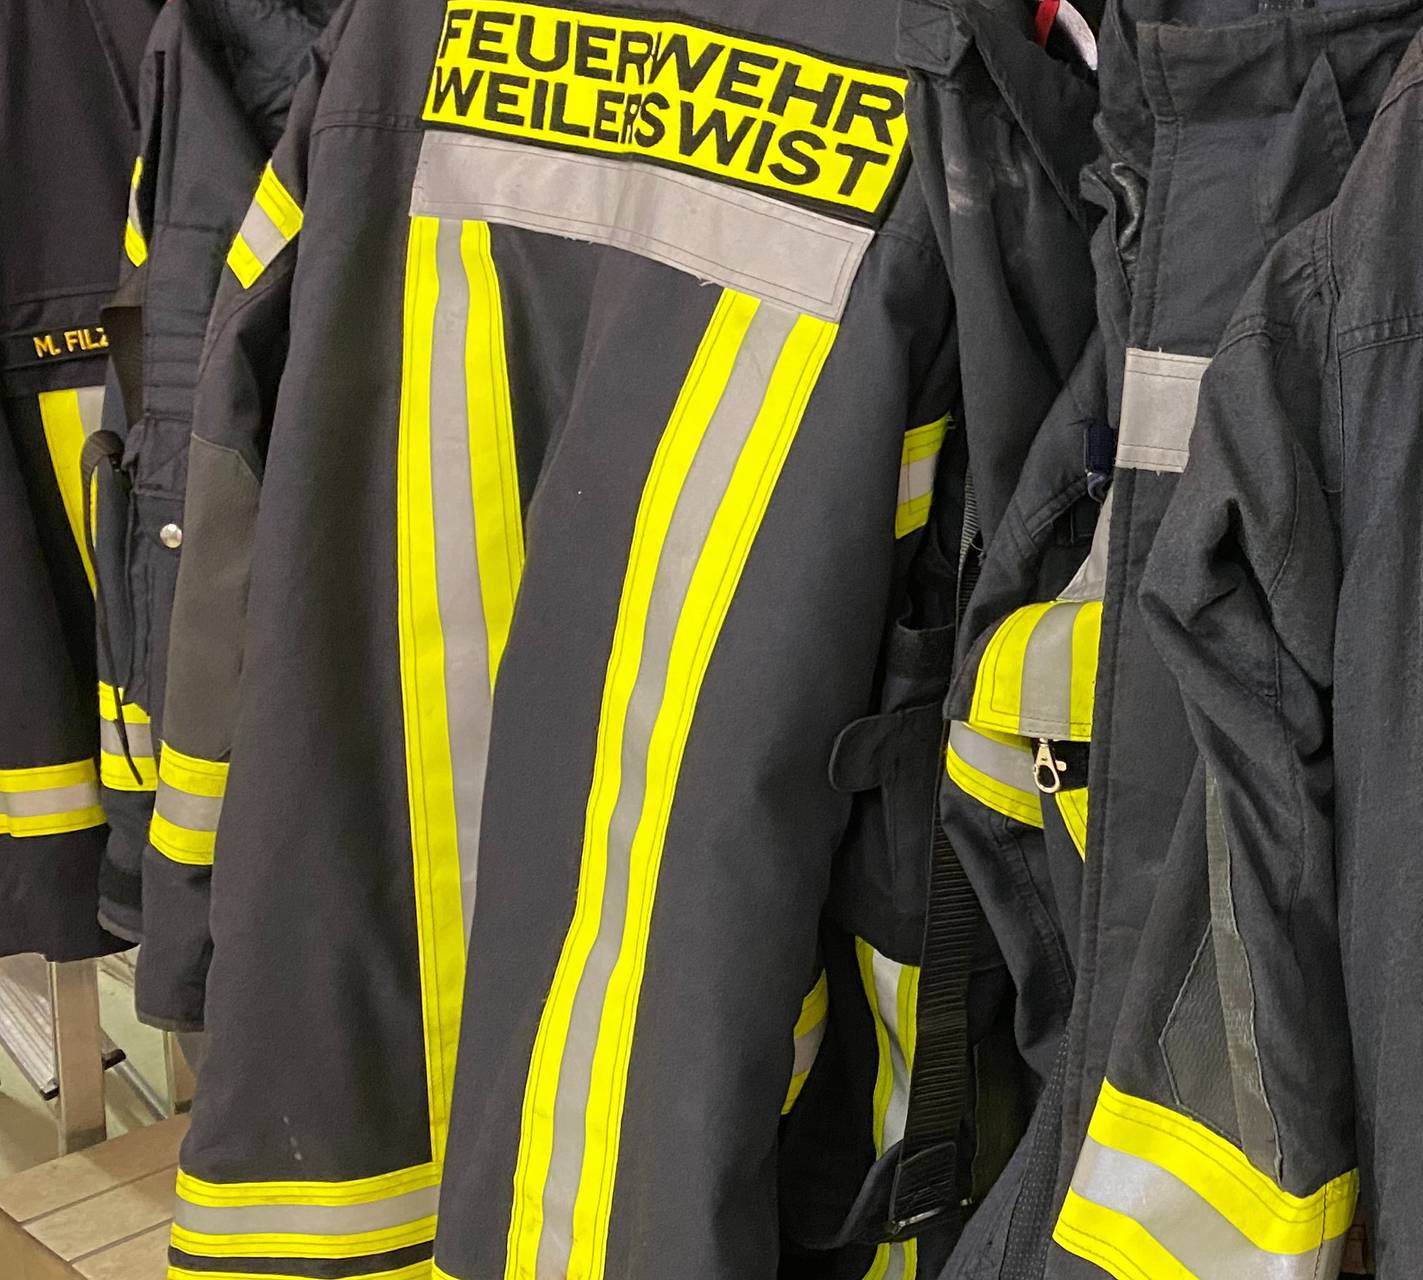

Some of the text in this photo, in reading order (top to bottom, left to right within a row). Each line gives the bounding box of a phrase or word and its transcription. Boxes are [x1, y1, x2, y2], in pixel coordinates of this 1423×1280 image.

[431, 67, 890, 197] WEILERSWIST
[439, 9, 905, 147] FEUERWEHR
[33, 335, 61, 358] M.
